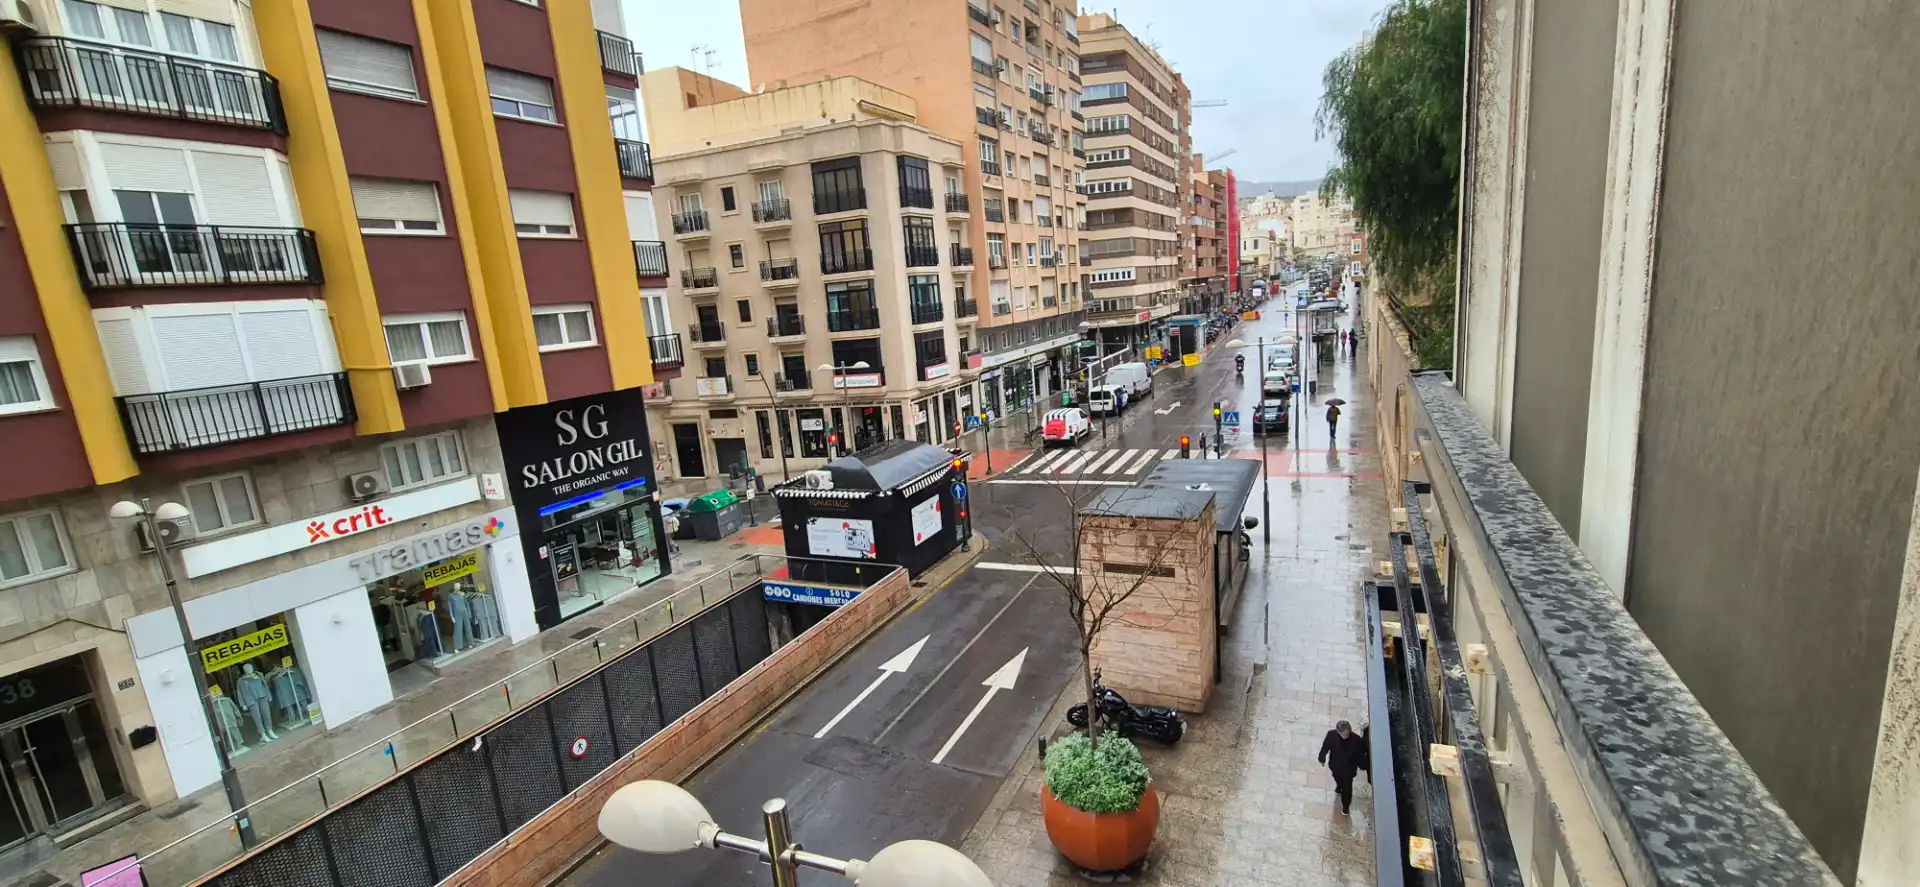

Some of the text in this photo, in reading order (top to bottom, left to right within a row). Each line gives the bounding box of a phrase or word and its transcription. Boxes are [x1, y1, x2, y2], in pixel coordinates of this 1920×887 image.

[555, 404, 609, 446] SG
[522, 439, 643, 488] SALON GIL
[553, 466, 629, 495] THE ORGANIC WAY
[333, 505, 393, 535] crit.
[424, 556, 476, 581] REBAJAS
[792, 593, 823, 604] CAMIONES
[829, 589, 851, 598] SOLO
[205, 628, 284, 663] REBAJAS
[0, 678, 36, 704] 38
